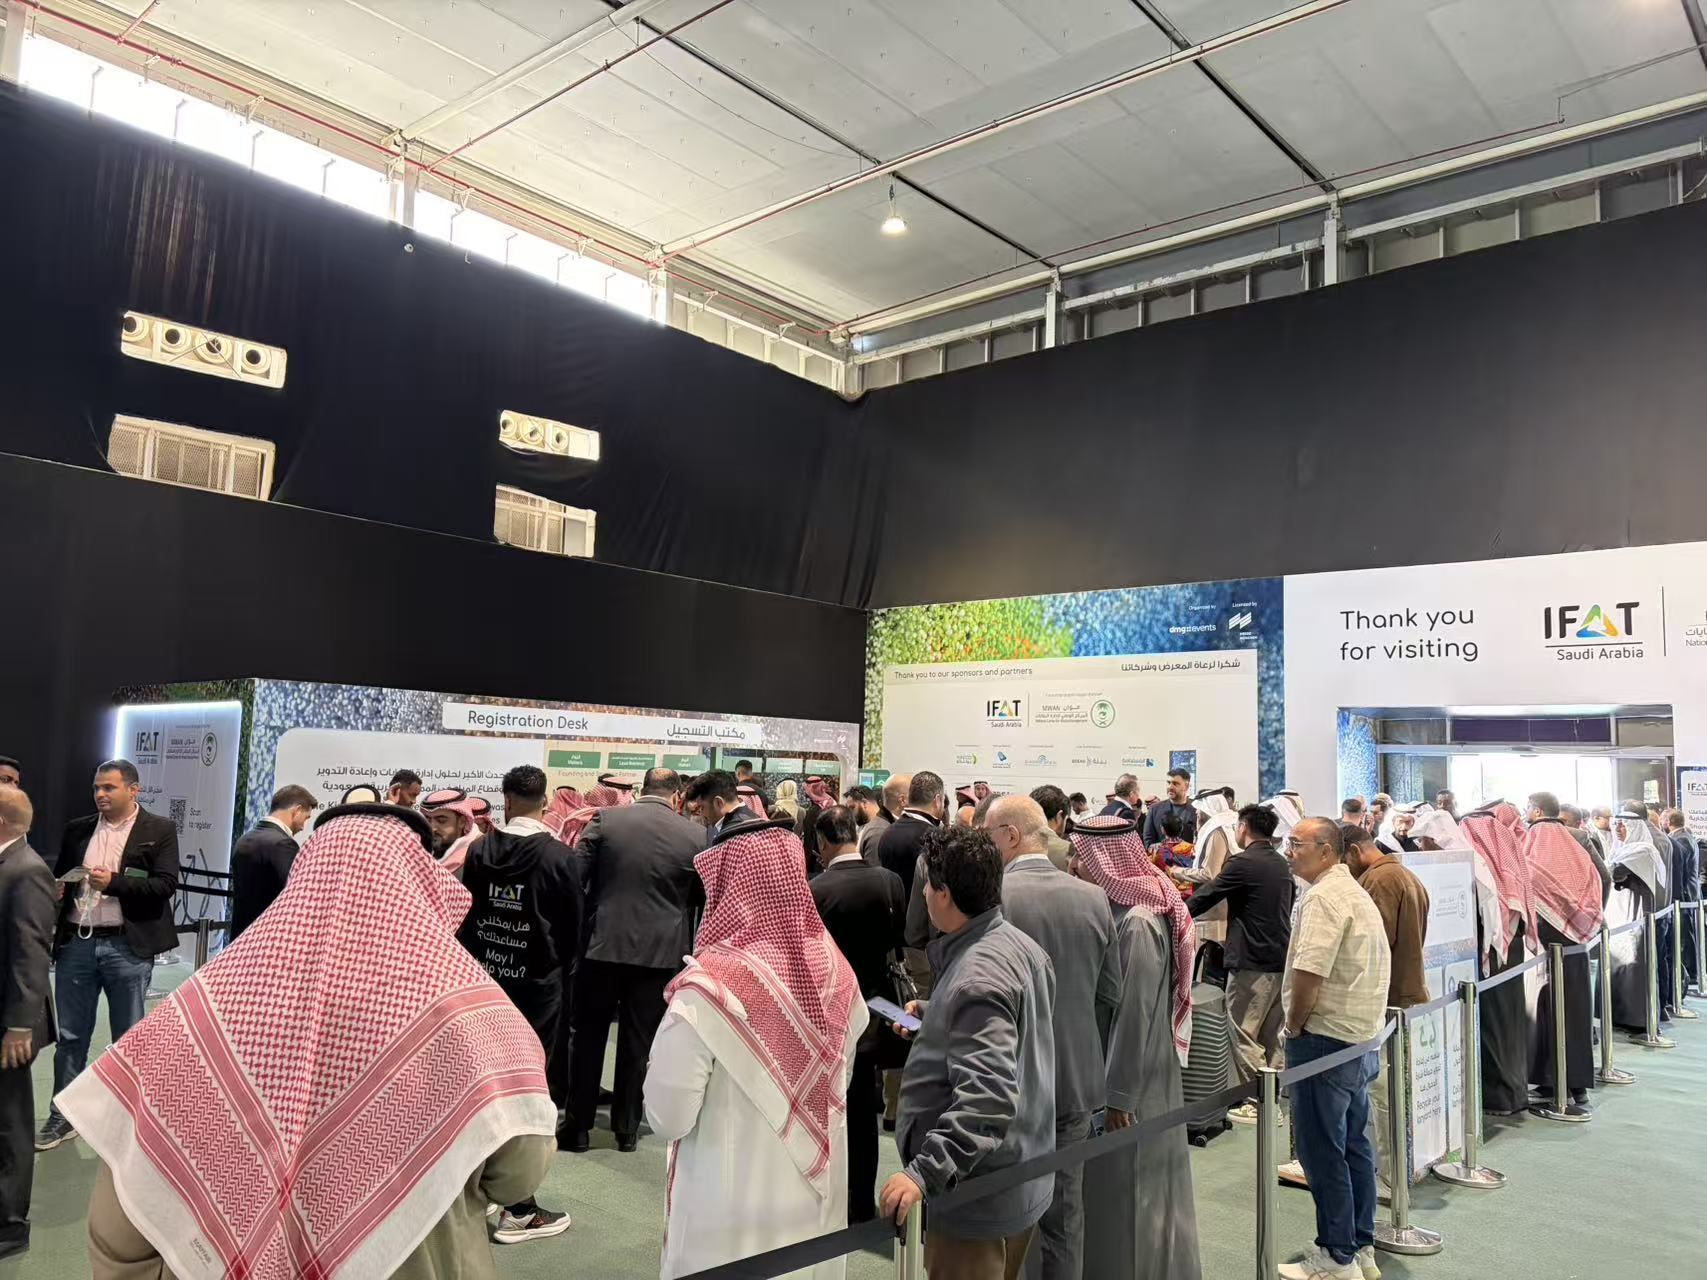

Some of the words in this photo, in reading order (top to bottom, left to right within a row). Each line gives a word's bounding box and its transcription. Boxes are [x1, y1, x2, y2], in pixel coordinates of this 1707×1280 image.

[1340, 608, 1417, 630] Thank
[1426, 610, 1473, 631] you
[1544, 602, 1639, 639] IFAT
[1340, 641, 1376, 660] for
[1383, 638, 1478, 662] visiting
[1557, 648, 1594, 660] Saudi
[1599, 647, 1643, 659] Arabia
[1159, 661, 1193, 672] المعرض
[1193, 659, 1215, 670] لرعاة
[1217, 657, 1240, 669] شكرا
[894, 671, 914, 679] Thank
[951, 670, 983, 678] sponsors
[984, 668, 999, 676] and
[1000, 668, 1032, 676] partners
[986, 700, 1021, 718] IFAT
[468, 710, 553, 728] Registration
[558, 716, 588, 730] Desk
[667, 724, 712, 739] التسجيل
[715, 727, 745, 740] مكتب
[136, 732, 159, 751] IFAT
[316, 766, 348, 777] التدوير
[350, 766, 377, 778] وإعادة
[435, 769, 461, 780] لحلول
[462, 768, 484, 780] الأكبر
[485, 767, 505, 779] حدث
[493, 901, 505, 909] Saudi
[512, 920, 531, 932] هل
[485, 947, 508, 966] May
[510, 953, 514, 965] I
[498, 965, 526, 979] you?
